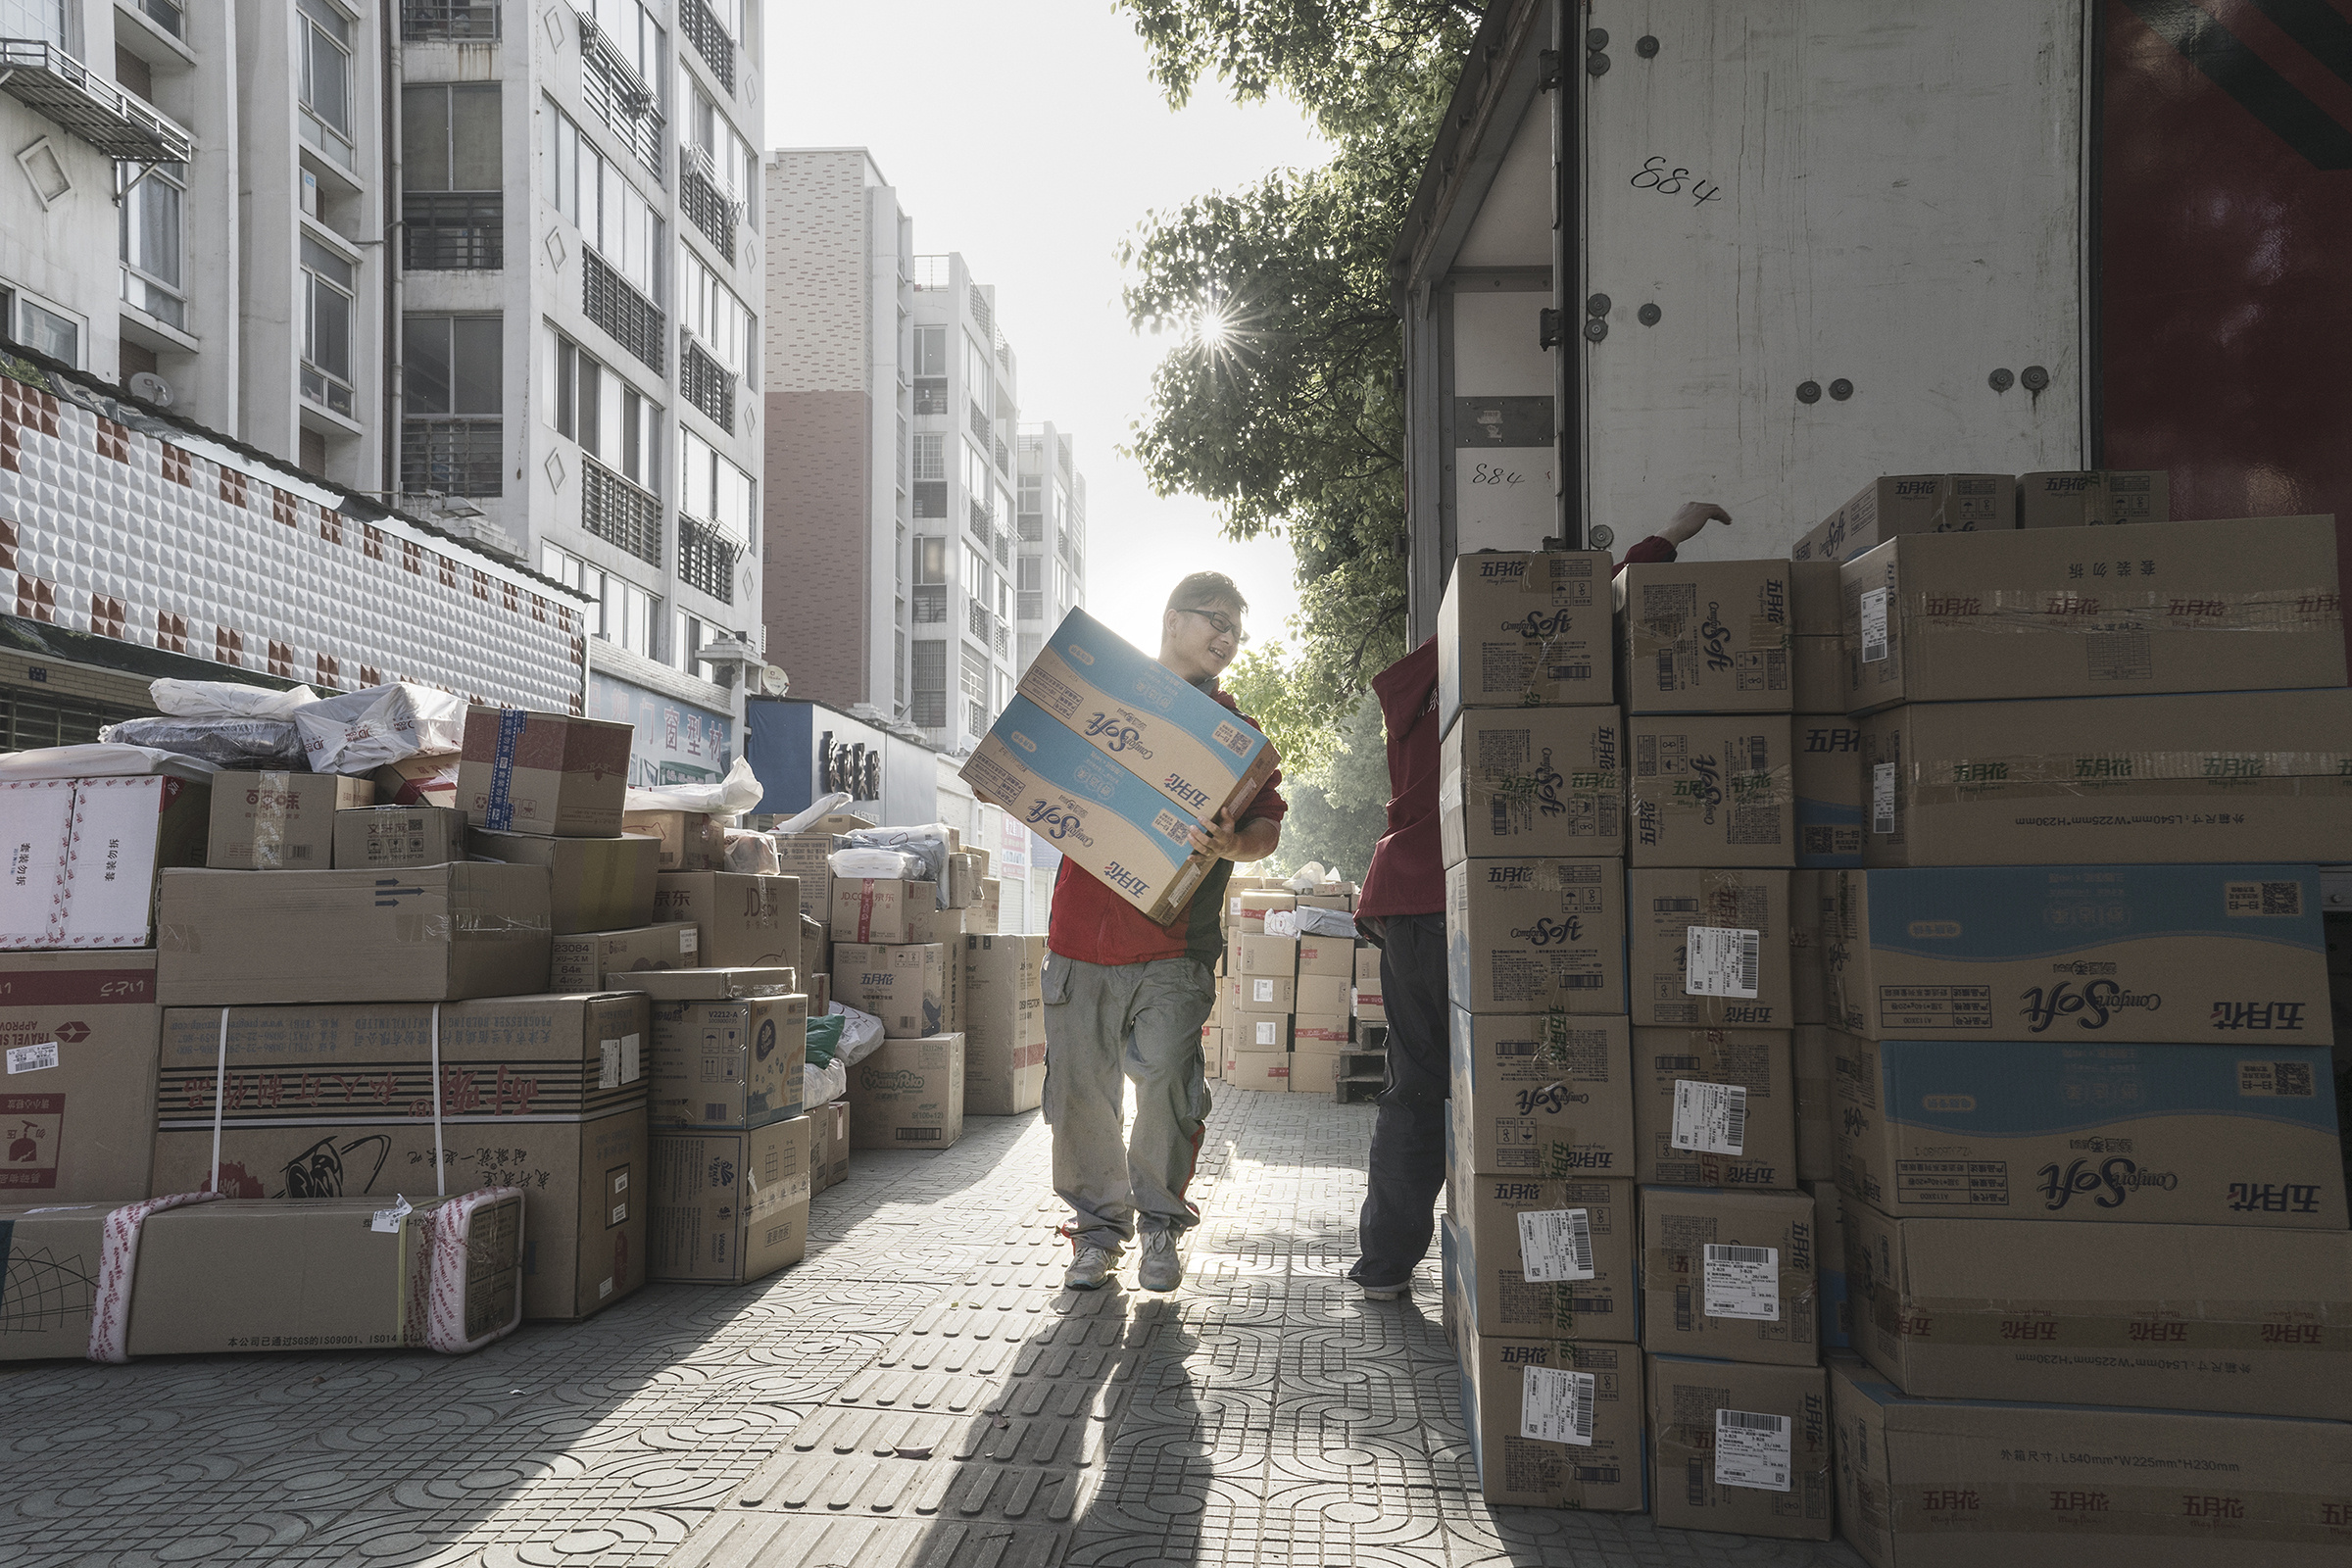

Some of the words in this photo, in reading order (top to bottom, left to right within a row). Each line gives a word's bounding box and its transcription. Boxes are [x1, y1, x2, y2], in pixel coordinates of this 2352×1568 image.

[1630, 155, 1722, 205] 884
[1472, 463, 1525, 489] 884
[1895, 481, 1938, 495] 五月花
[2044, 477, 2086, 492] 五月花
[1828, 511, 1845, 558] Soft
[1480, 561, 1525, 577] 五月花
[2069, 560, 2156, 579] 套装勿拆
[1767, 578, 1784, 623] 五月花
[1927, 597, 1982, 615] 五月花
[2044, 597, 2099, 615] 五月花
[2167, 599, 2225, 617] 五月花
[1521, 609, 1573, 637] Soft
[1701, 621, 1734, 672] Soft
[1080, 709, 1141, 754] Soft
[1598, 726, 1615, 770] 五月花
[1690, 755, 1722, 805] Soft
[1953, 761, 2008, 782] 五月花
[2075, 758, 2132, 777] 五月花
[2203, 757, 2264, 777] 五月花
[1161, 771, 1210, 810] 五月花
[1536, 767, 1566, 817] Soft
[1021, 796, 1082, 841] Soft
[1640, 801, 1656, 847] 五月花
[1101, 859, 1151, 900] 五月花
[1488, 866, 1533, 882] 五月花
[2229, 901, 2260, 910] 扫一扫
[1531, 915, 1583, 946] Soft
[554, 944, 590, 953] 23084
[860, 973, 894, 985] 五月花
[1726, 1006, 1773, 1023] 五月花
[2019, 980, 2121, 1033] Soft
[2209, 1001, 2307, 1030] 五月花
[2241, 1080, 2274, 1090] 扫一扫
[1515, 1085, 1567, 1116] Soft
[1567, 1152, 1613, 1168] 五月花
[1728, 1166, 1776, 1184] 五月花
[2035, 1157, 2137, 1210] Soft
[1494, 1183, 1540, 1200] 五月花
[2227, 1183, 2321, 1213] 五月花
[1792, 1220, 1810, 1270] 五月花
[2000, 1320, 2058, 1340] 五月花
[2129, 1321, 2188, 1341] 五月花
[2261, 1322, 2323, 1344] 五月花
[1500, 1347, 1546, 1363] 五月花
[1805, 1392, 1823, 1443] 五月花
[1923, 1490, 1981, 1510] 五月花
[2049, 1491, 2109, 1512] 五月花
[2181, 1494, 2244, 1519] 五月花
